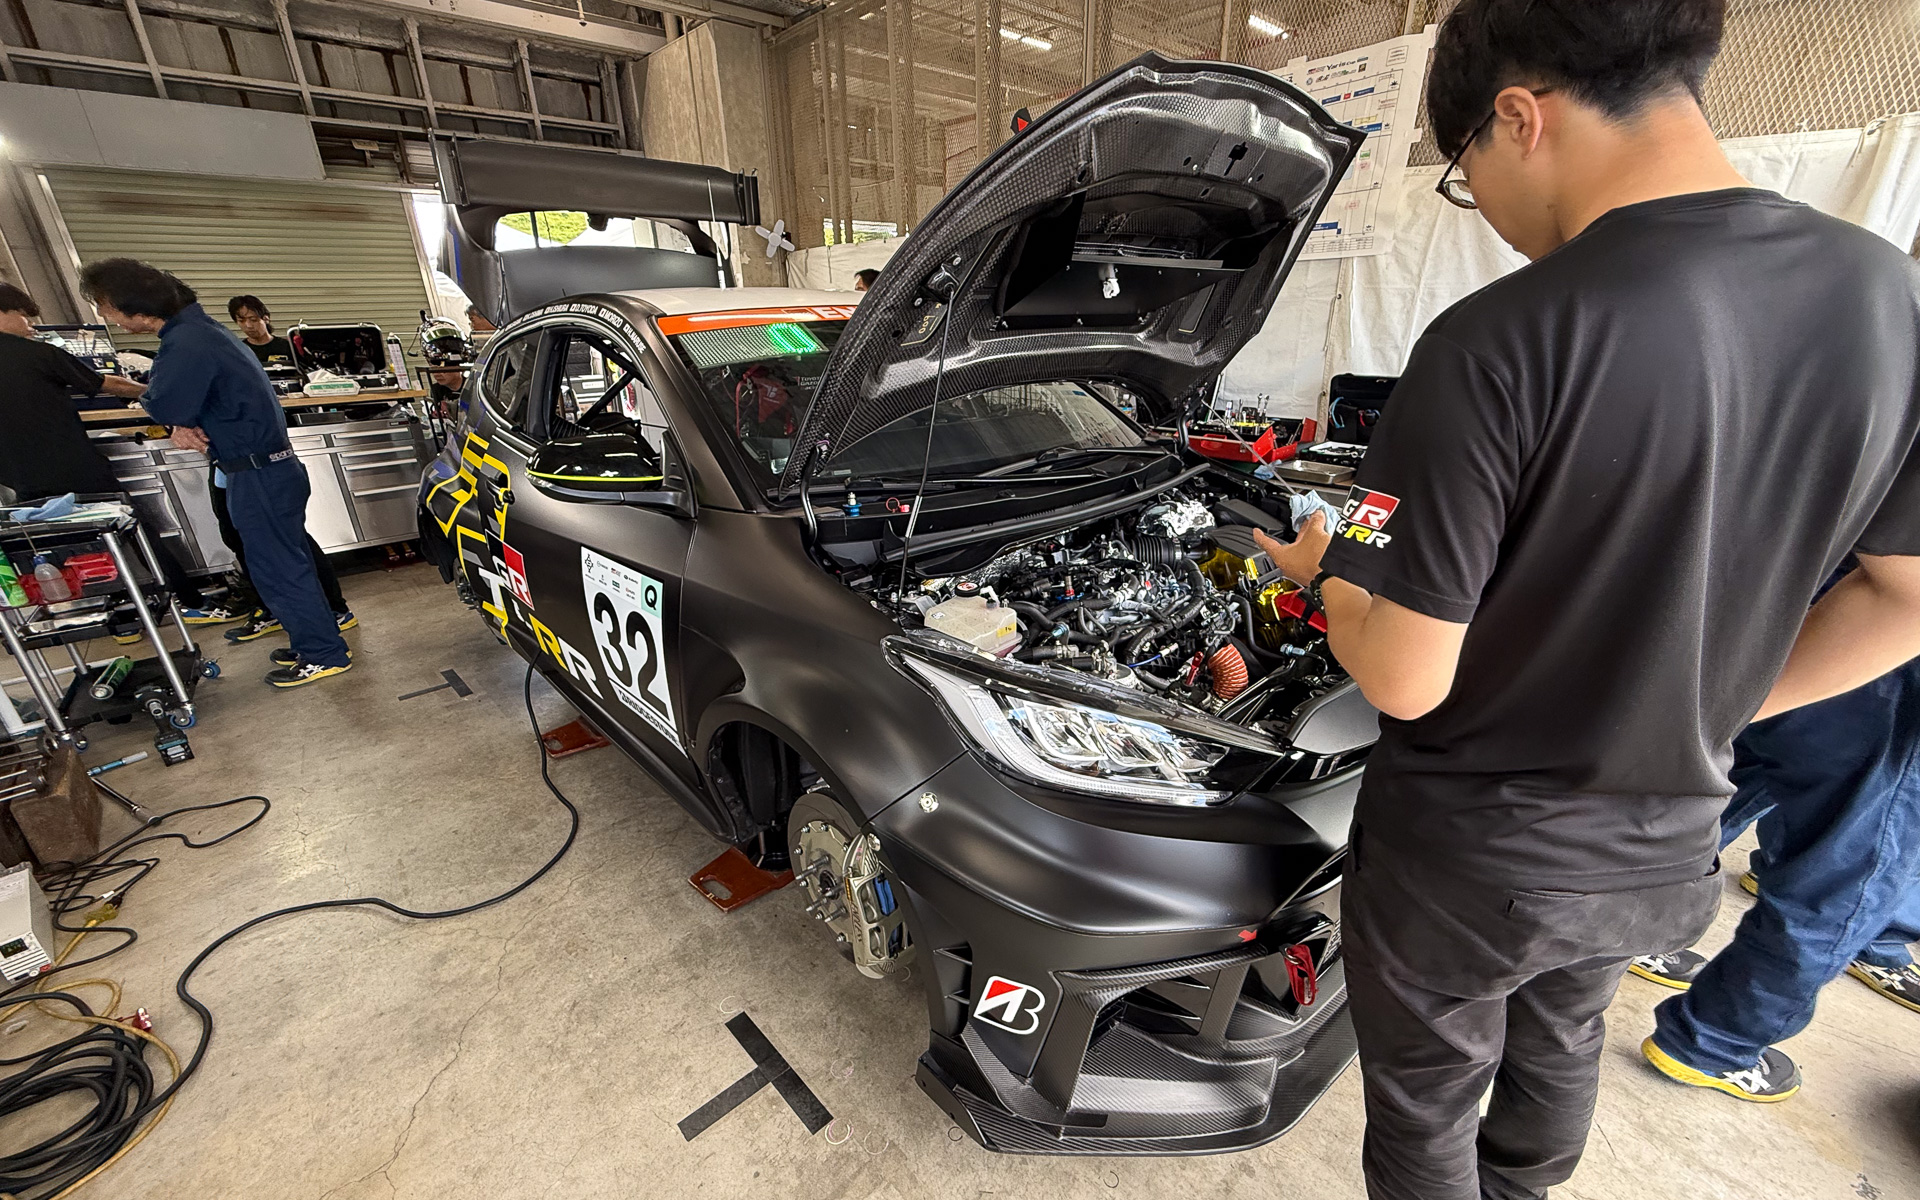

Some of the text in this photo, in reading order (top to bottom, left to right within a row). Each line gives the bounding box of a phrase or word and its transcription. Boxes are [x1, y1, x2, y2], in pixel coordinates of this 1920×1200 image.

[1327, 60, 1346, 70] Yaris
[605, 309, 623, 328] MORIZO
[1343, 499, 1389, 527] GR
[492, 555, 532, 605] GR
[645, 585, 657, 610] Q
[593, 591, 671, 721] 32
